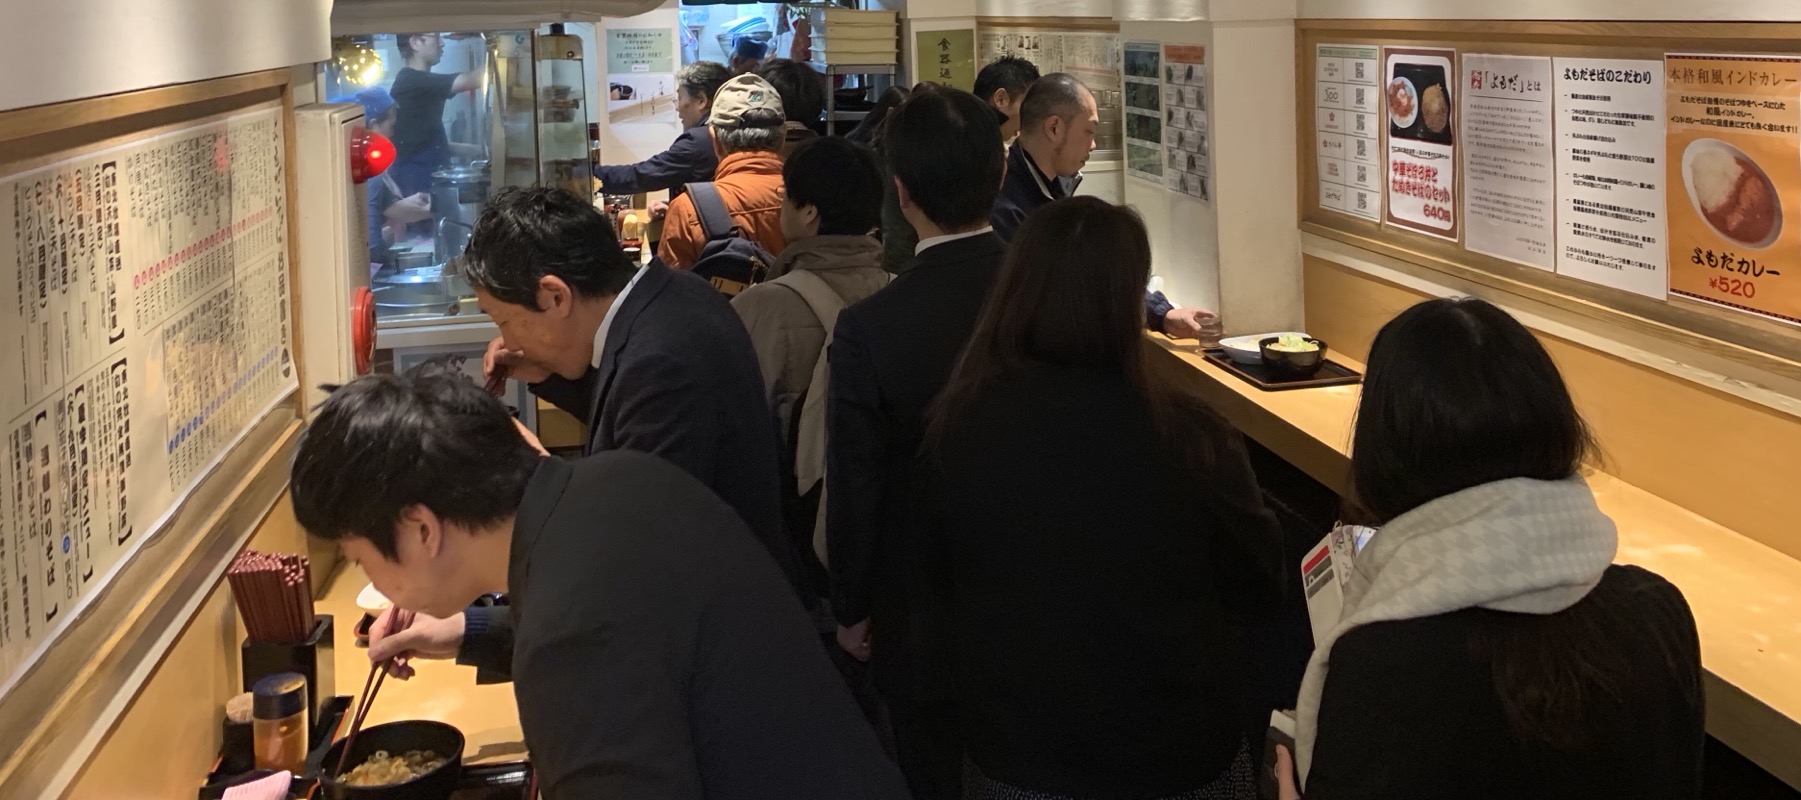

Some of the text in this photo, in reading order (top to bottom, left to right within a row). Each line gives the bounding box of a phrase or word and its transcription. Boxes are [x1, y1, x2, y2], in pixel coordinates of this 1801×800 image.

[1485, 70, 1541, 93] 「よもだ」とは
[1563, 67, 1652, 84] よもだそばのこだわり
[1670, 67, 1797, 86] 本格和風インドカレー
[1680, 95, 1786, 110] よもだそば自慢のそばつゆをベースにした
[1392, 178, 1450, 205] たぬきそばのセット
[1423, 203, 1451, 222] 640円
[1691, 246, 1781, 277] よもだカレー
[1709, 276, 1756, 299] ¥520
